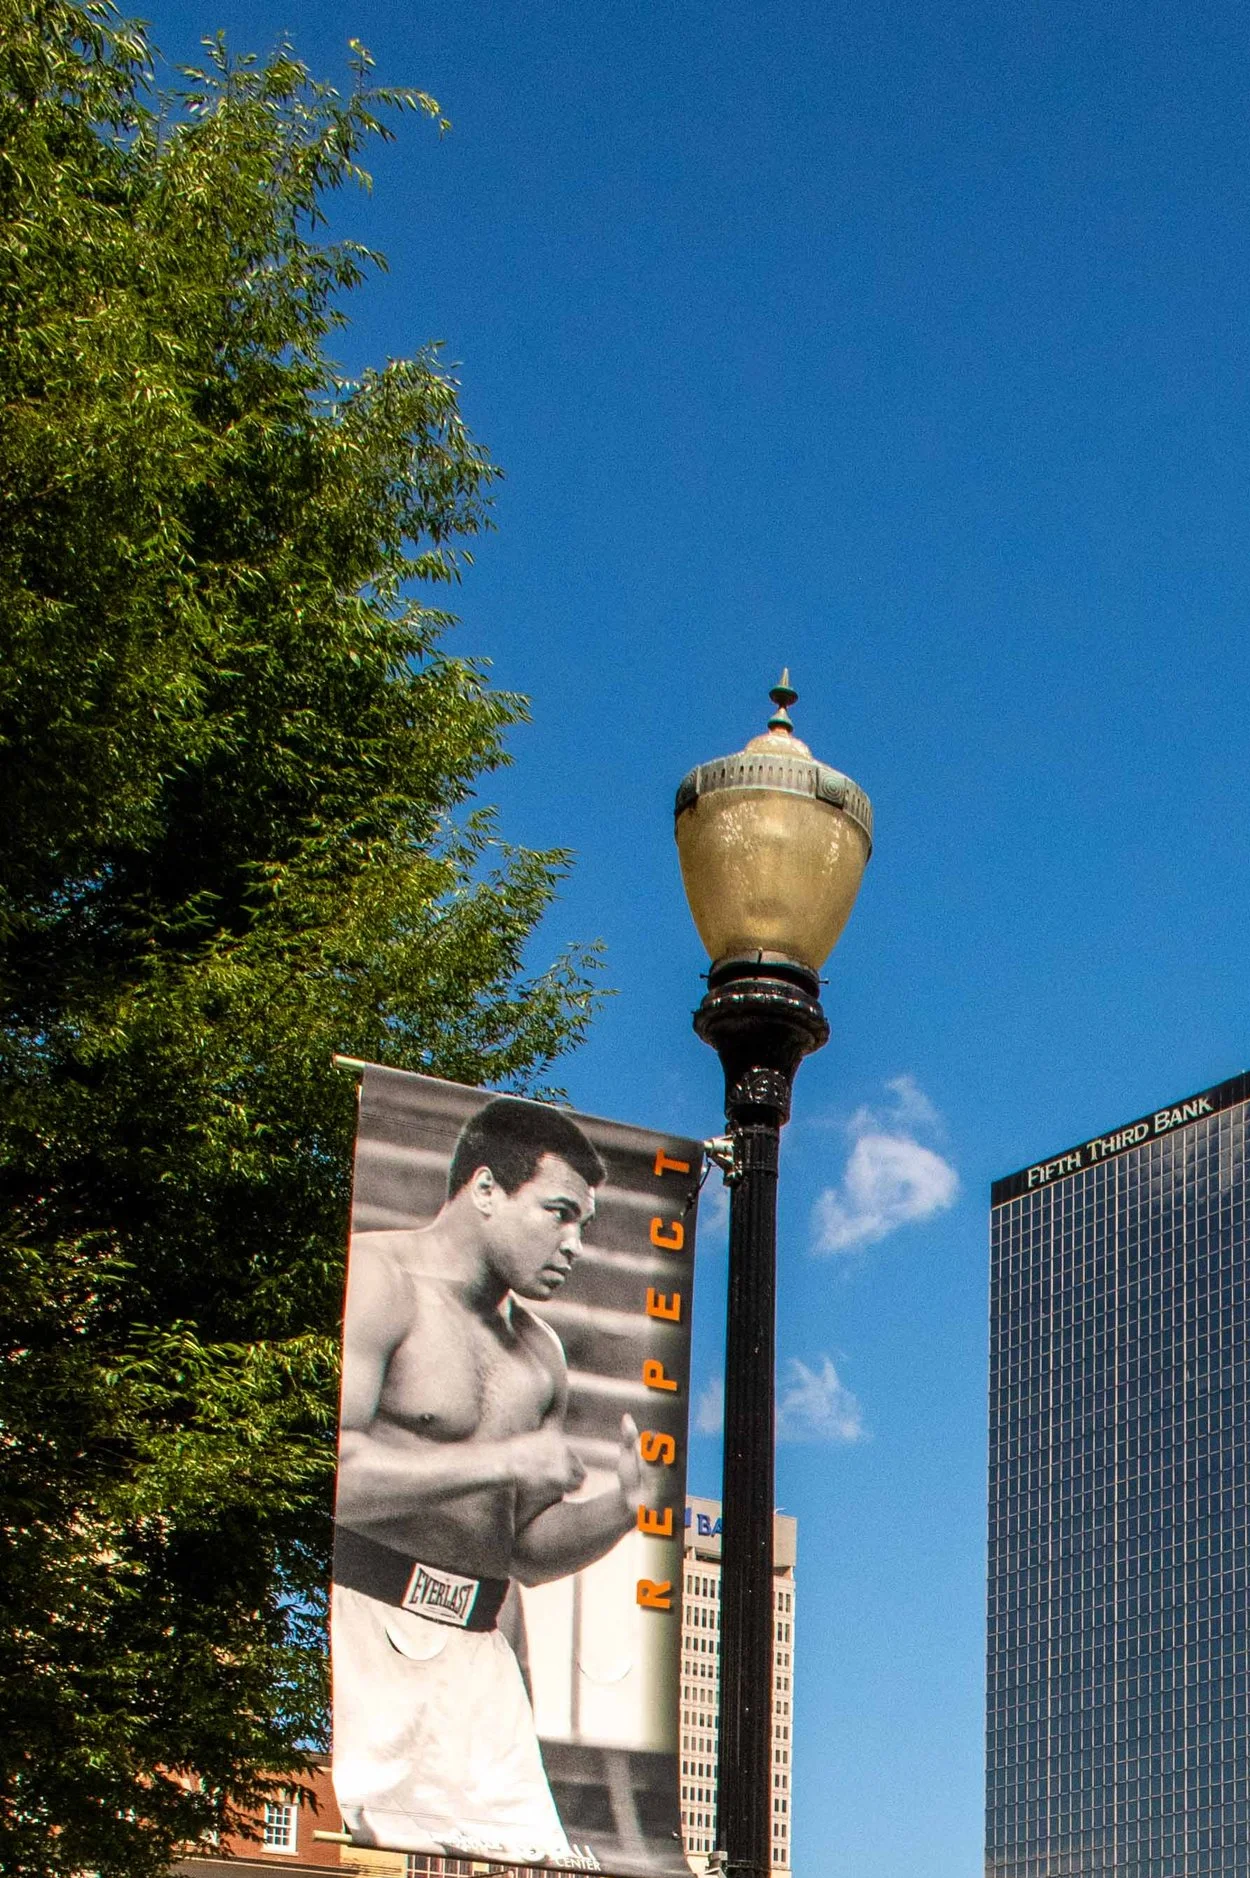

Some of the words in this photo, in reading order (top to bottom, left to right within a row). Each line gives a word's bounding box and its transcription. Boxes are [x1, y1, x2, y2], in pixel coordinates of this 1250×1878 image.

[1027, 1151, 1082, 1188] FIFTH
[1087, 1123, 1149, 1161] THIRD
[1154, 1097, 1214, 1134] BANK
[636, 1148, 690, 1610] RESPECT
[408, 1567, 475, 1619] EVERLAST
[555, 1856, 601, 1871] CENTER
